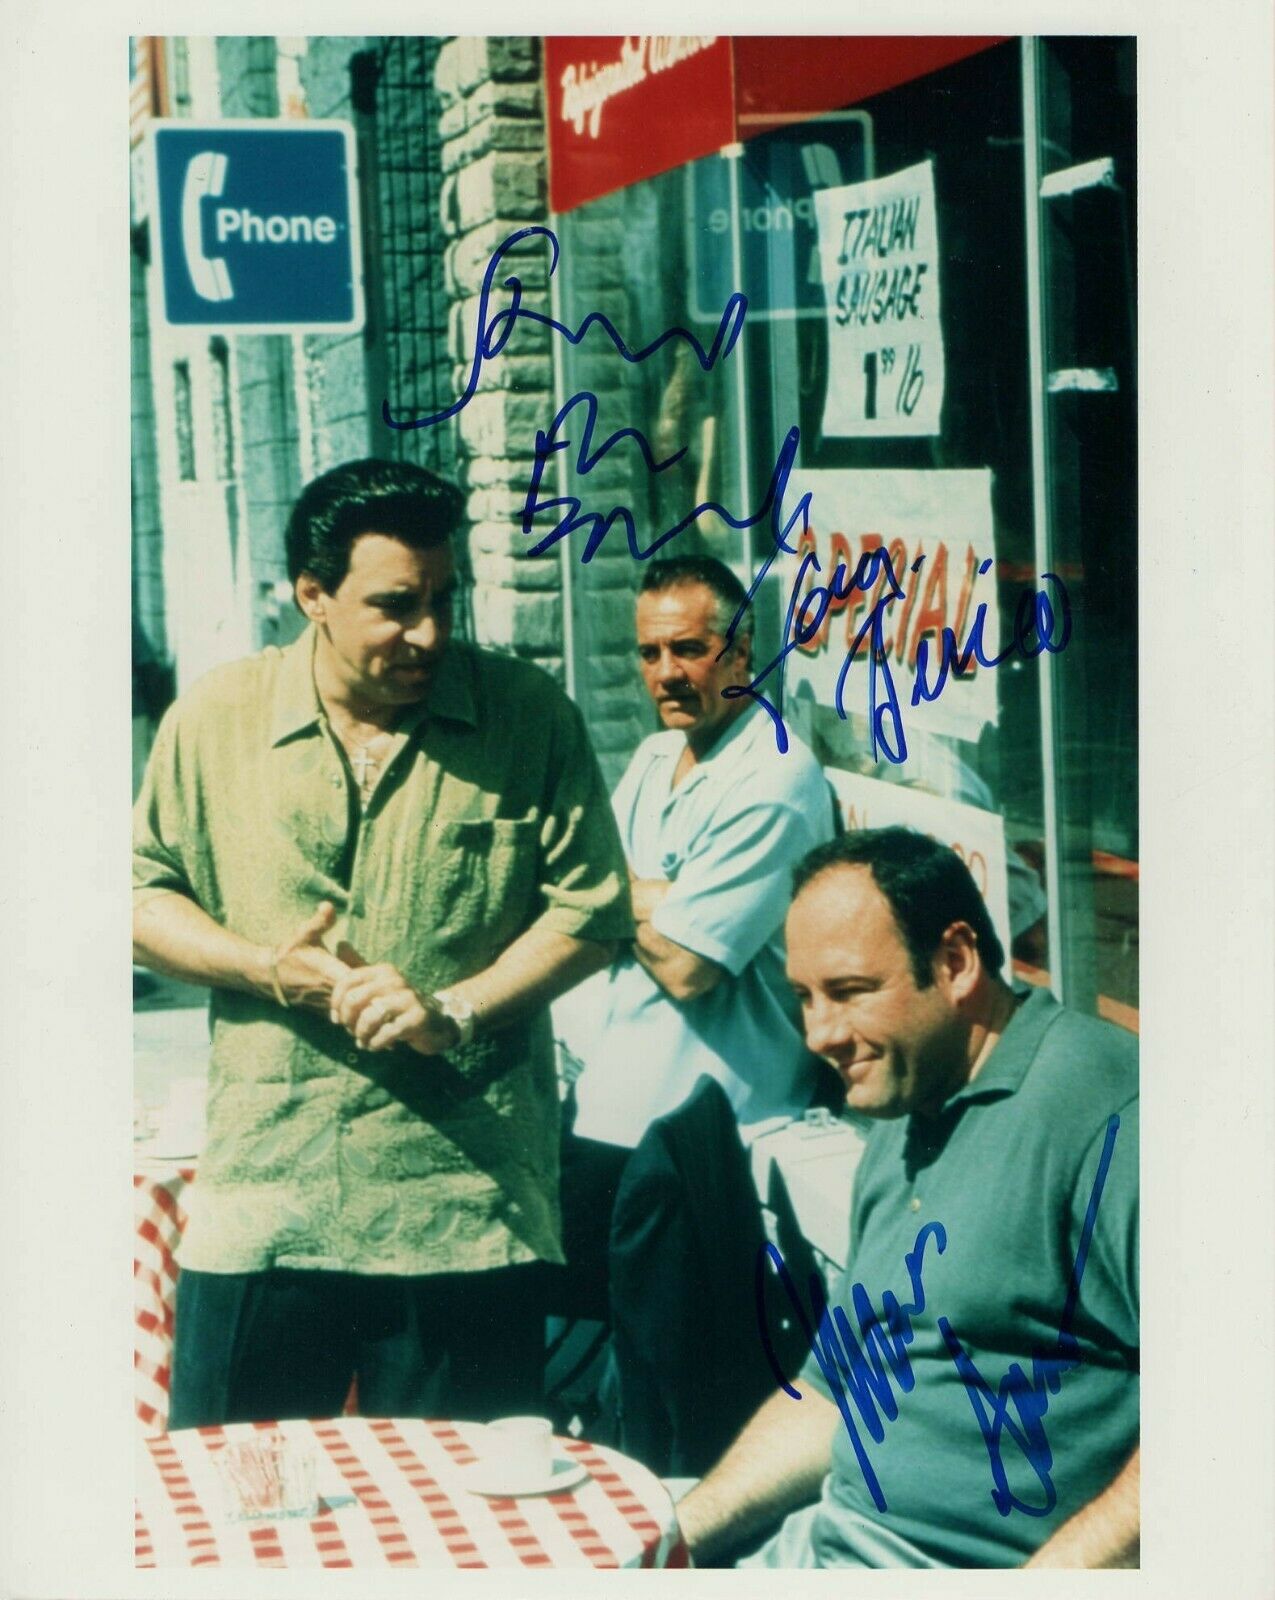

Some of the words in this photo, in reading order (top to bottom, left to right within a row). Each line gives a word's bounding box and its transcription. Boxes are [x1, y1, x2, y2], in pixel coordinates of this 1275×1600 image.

[216, 207, 337, 243] Phone
[836, 263, 928, 326] SAUSAGE
[793, 526, 978, 681] SPECIAL
